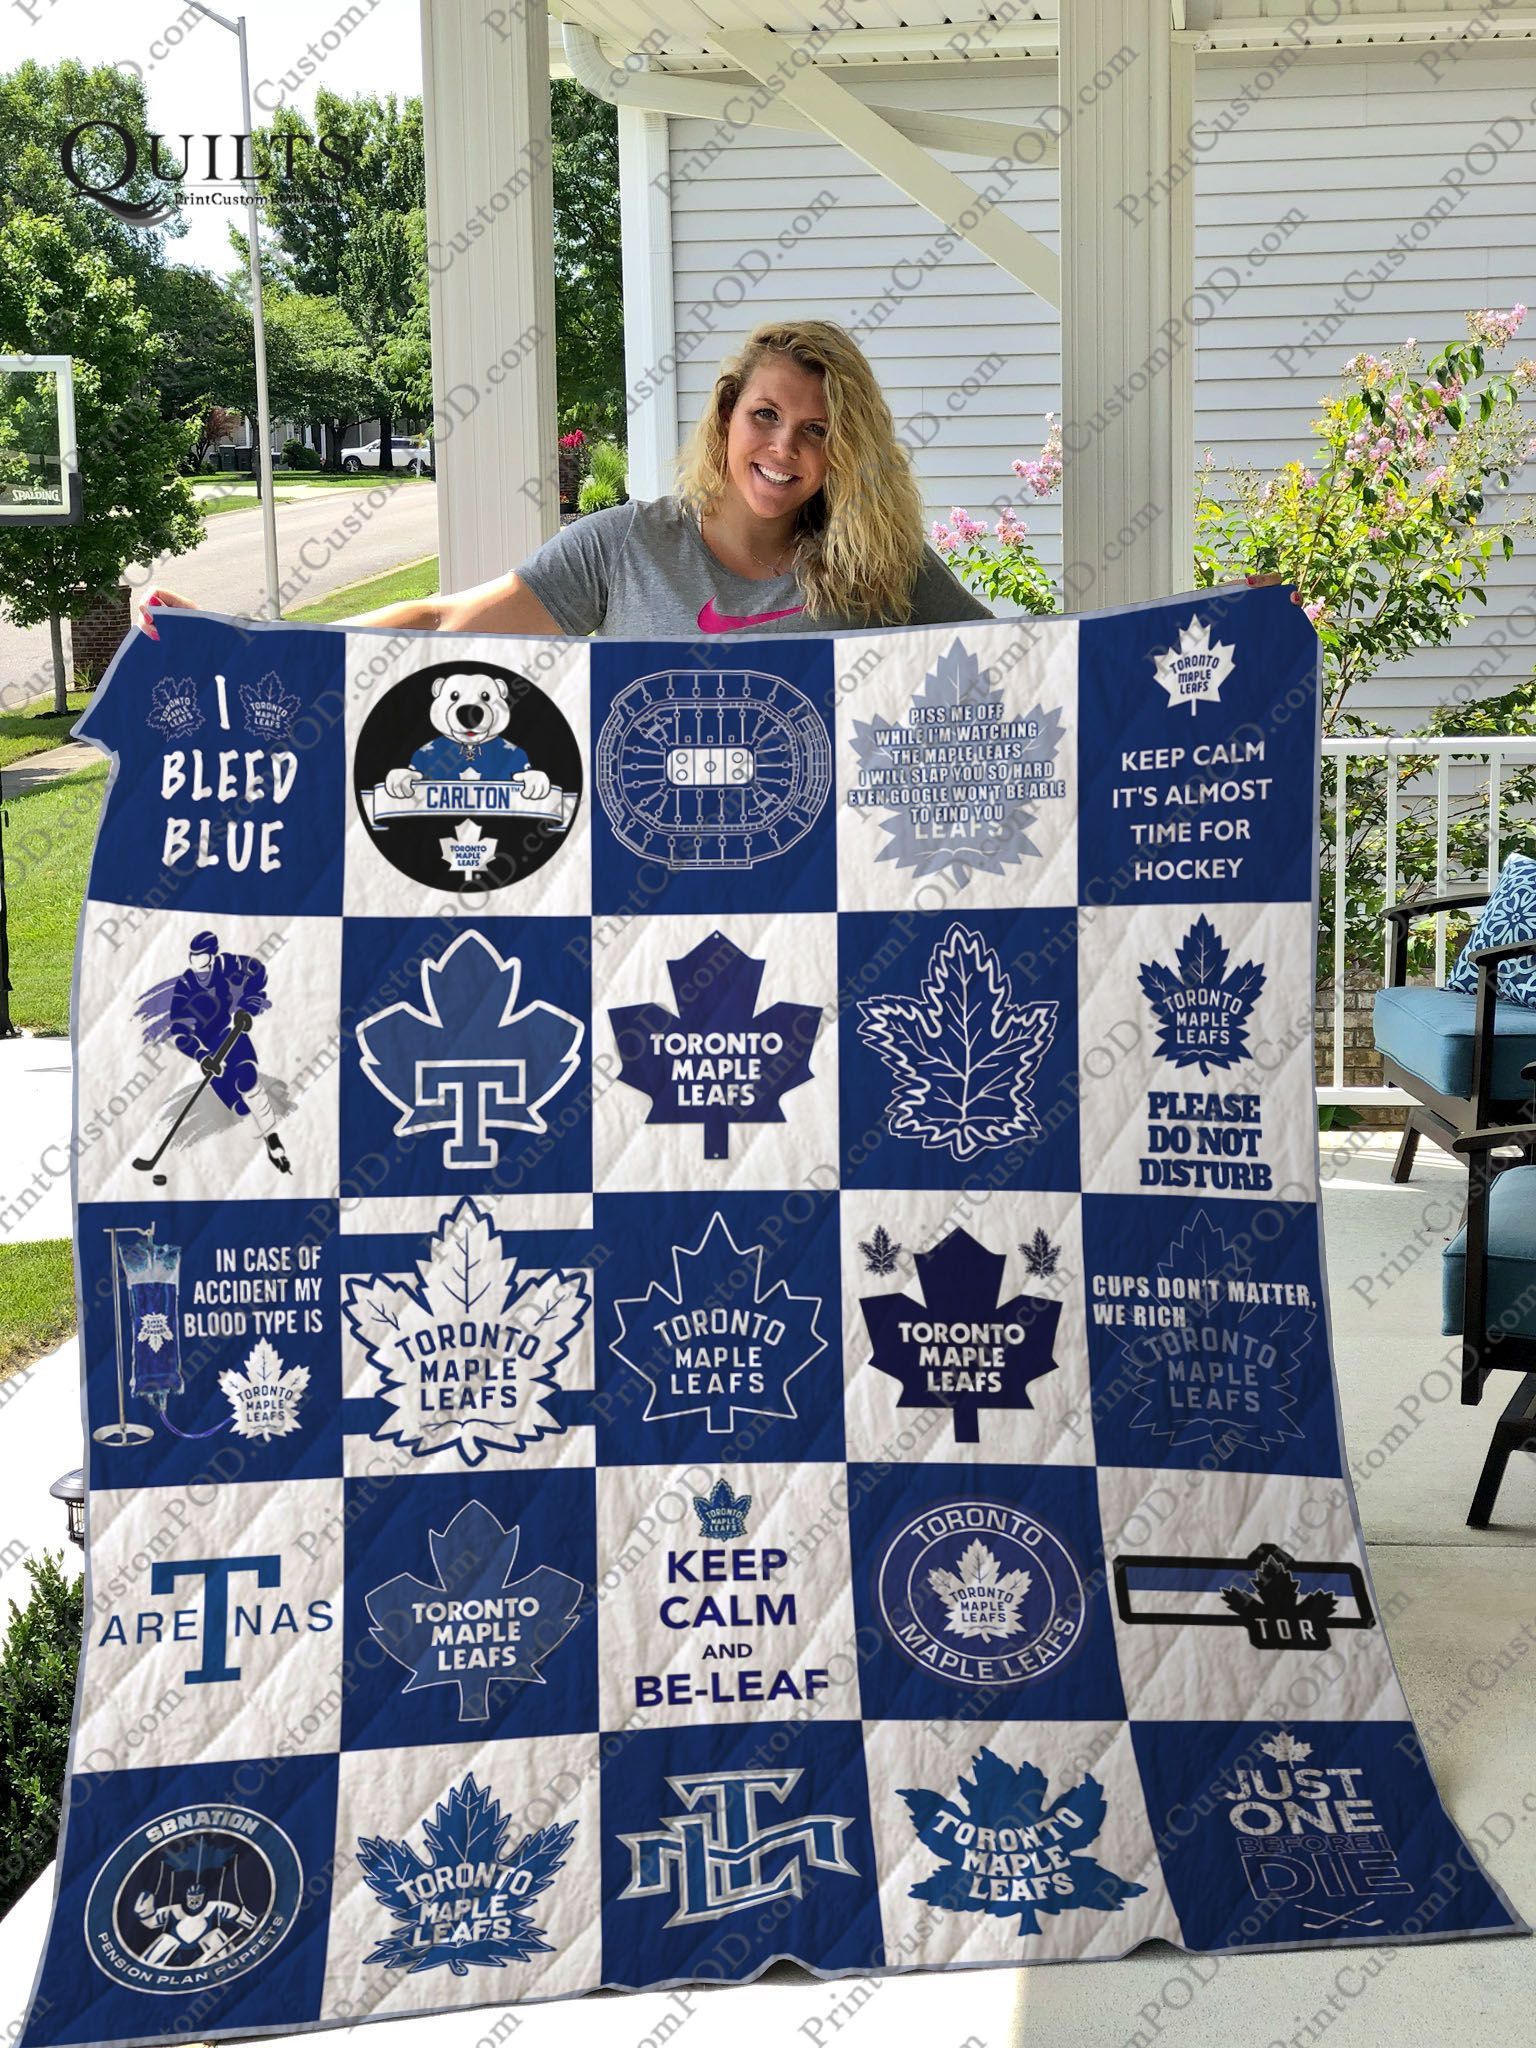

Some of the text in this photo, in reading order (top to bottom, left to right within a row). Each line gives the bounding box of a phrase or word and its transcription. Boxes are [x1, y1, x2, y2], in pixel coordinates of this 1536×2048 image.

[12, 489, 61, 502] SPALDING
[1169, 654, 1219, 674] TORONTO
[1178, 669, 1211, 684] MAPLE
[1180, 680, 1209, 695] LEAFS
[159, 696, 191, 722] TORONTO
[214, 674, 231, 731] I
[250, 700, 288, 718] TORONTO
[910, 703, 1004, 726] PISS ME OFF
[169, 713, 193, 728] LEAFS
[254, 718, 281, 729] LEAFS
[255, 710, 281, 722] MAPLE
[875, 722, 1038, 747] WHILE I'M WATCHING
[892, 743, 1022, 765] THE MAPLE LEAFS
[1122, 741, 1265, 772] KEEP CALM
[161, 749, 298, 804] BLEED
[870, 768, 907, 786] WILL
[911, 765, 949, 784] SLAP
[952, 765, 983, 781] YOU
[988, 763, 1007, 781] SO
[1012, 761, 1054, 779] HARD
[426, 786, 510, 809] CARLTON
[848, 780, 1066, 807] EVEN GOOGLE WON'T BE ABLE
[1112, 778, 1272, 808] IT'S ALMOST
[911, 804, 1004, 825] TO FIND YOU
[162, 817, 284, 873] BLUE
[1130, 820, 1250, 845] TIME FOR
[1135, 858, 1243, 881] HOCKEY
[1163, 988, 1243, 1015] TORONTO
[1176, 1011, 1230, 1028] MAPLE
[650, 1032, 783, 1055] TORONTO
[1176, 1029, 1230, 1045] LEAFS
[671, 1058, 761, 1081] MAPLE
[677, 1083, 755, 1106] LEAFS
[1147, 1091, 1261, 1124] PLEASE
[1147, 1124, 1262, 1158] DO NOT
[1139, 1158, 1273, 1192] DISTURB
[216, 1245, 322, 1273] IN CASE OF
[193, 1277, 322, 1305] ACCIDENT MY
[1092, 1274, 1317, 1309] CUPS DON'T MATTER,
[184, 1311, 247, 1338] BLOOD
[252, 1310, 297, 1335] TYPE
[304, 1309, 323, 1333] IS
[653, 1308, 786, 1347] TORONTO
[1093, 1303, 1187, 1328] WE RICH
[394, 1321, 541, 1363] TORONTO
[897, 1321, 1026, 1345] TORONTO
[675, 1347, 762, 1368] MAPLE
[918, 1345, 1006, 1368] MAPLE
[1143, 1327, 1277, 1369] TORONTO
[420, 1358, 517, 1383] MAPLE
[927, 1371, 1002, 1393] LEAFS
[1167, 1360, 1259, 1386] MAPLE
[236, 1385, 293, 1401] TORONTO
[670, 1372, 764, 1395] LEAFS
[246, 1399, 284, 1411] MAPLE
[420, 1385, 517, 1411] LEAFS
[1170, 1386, 1260, 1413] LEAFS
[246, 1410, 285, 1423] LEAFS
[705, 1508, 744, 1520] TORONTO
[710, 1517, 736, 1525] MAPLE
[709, 1523, 737, 1532] LEAFS
[910, 1508, 1043, 1547] TORONTO
[668, 1548, 788, 1584] KEEP
[948, 1586, 1014, 1604] TORONTO
[960, 1601, 1005, 1612] MAPLE
[411, 1596, 539, 1624] TORONTO
[659, 1593, 797, 1630] CALM
[962, 1613, 1006, 1623] LEAFS
[431, 1621, 521, 1647] MAPLE
[1254, 1618, 1317, 1641] TOR
[438, 1646, 517, 1671] LEAFS
[702, 1643, 753, 1660] AND
[899, 1617, 1075, 1679] MAPLE LEAFS
[634, 1669, 829, 1708] BE-LEAF
[1224, 1767, 1363, 1801] JUST
[145, 1810, 258, 1843] SBNATION
[932, 1807, 1083, 1852] TORONTO
[1228, 1799, 1384, 1836] ONE
[1236, 1833, 1370, 1854] BEFORE
[961, 1845, 1071, 1877] MAPLE
[395, 1862, 533, 1905] TORONTO
[968, 1873, 1075, 1901] LEAFS
[1240, 1850, 1415, 1901] DIE
[420, 1894, 509, 1924] MAPLE
[413, 1917, 511, 1947] LEAFS
[97, 1914, 284, 1985] PENSION PLAN PUPPETS
